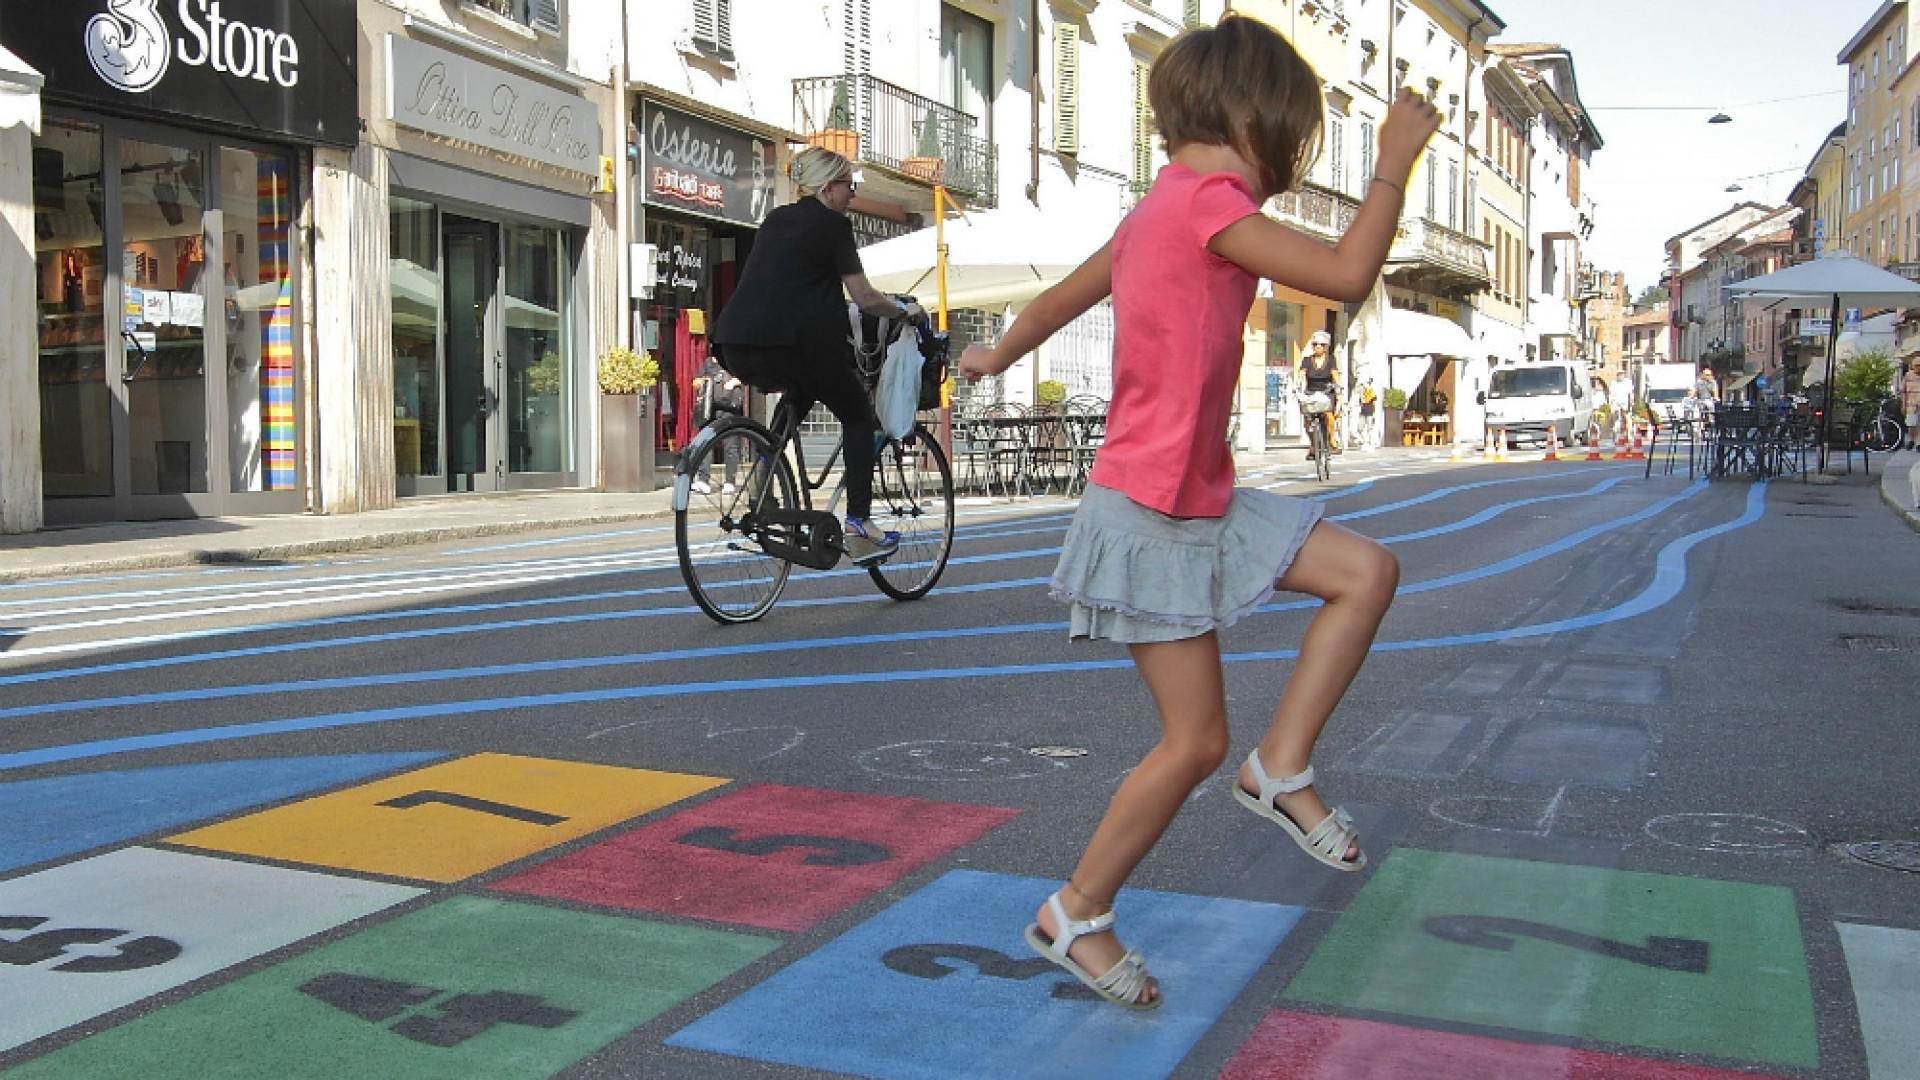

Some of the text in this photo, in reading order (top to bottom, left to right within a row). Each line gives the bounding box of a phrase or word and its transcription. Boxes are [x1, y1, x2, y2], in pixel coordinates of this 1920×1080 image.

[178, 1, 298, 87] Store
[652, 111, 738, 176] Osteria
[670, 826, 893, 866] 5
[1420, 915, 1710, 973] 2
[295, 971, 585, 1048] 4
